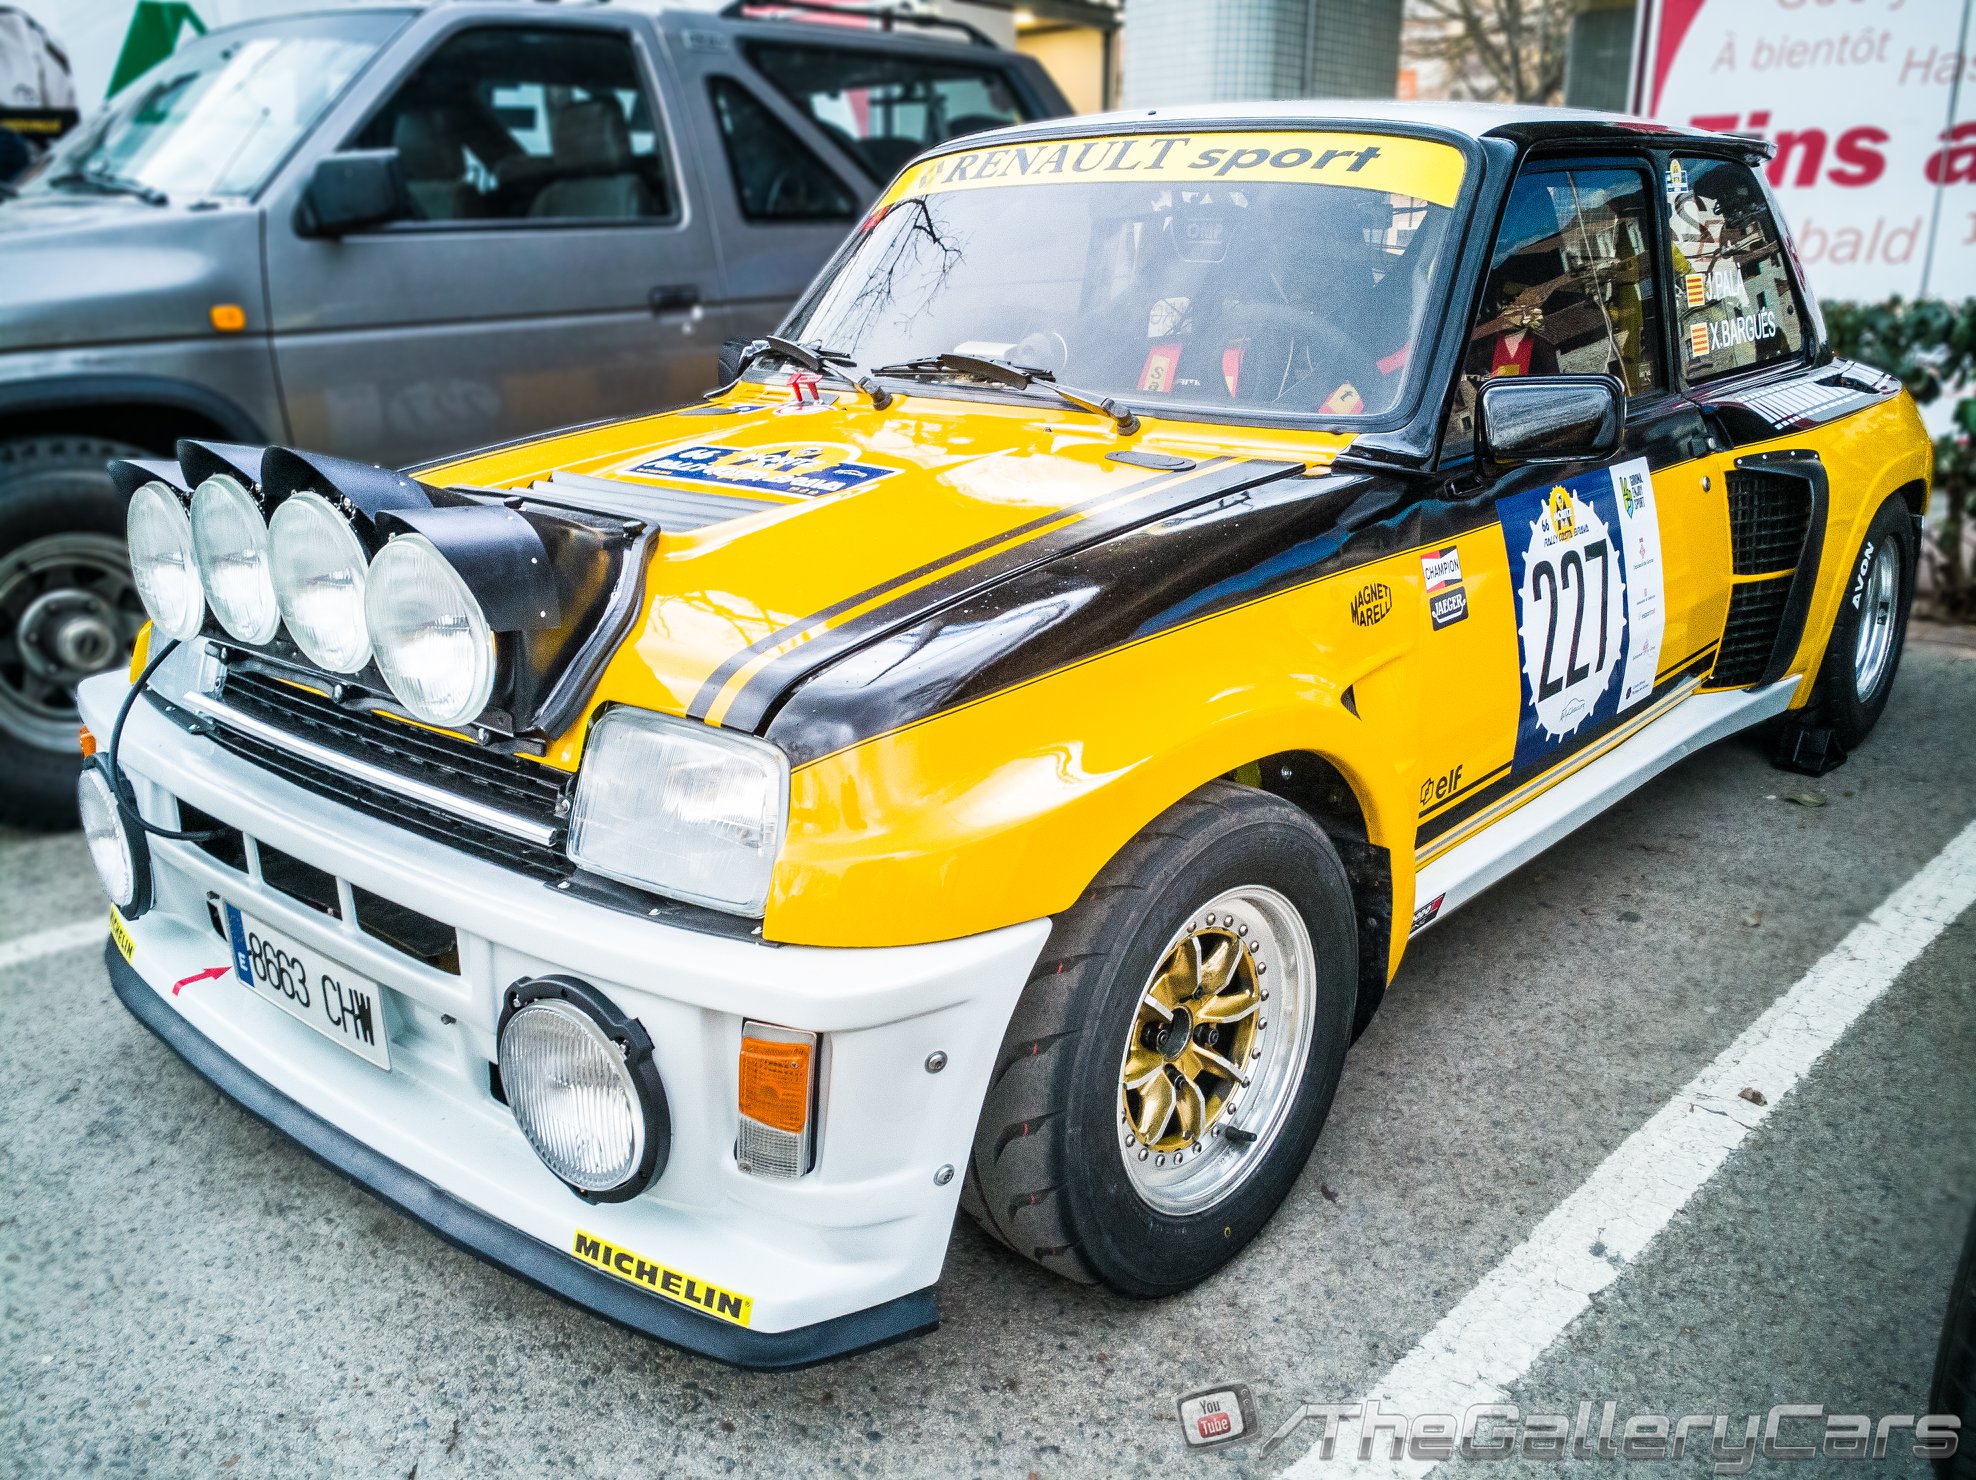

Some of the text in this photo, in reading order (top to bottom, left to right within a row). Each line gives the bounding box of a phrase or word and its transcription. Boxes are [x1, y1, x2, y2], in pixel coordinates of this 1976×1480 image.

[1751, 25, 1892, 72] bientôt
[941, 137, 1382, 183] RENAULT sport
[1690, 110, 1891, 188] ns
[1425, 559, 1459, 580] CHAMPION
[1852, 541, 1874, 610] AVON
[1432, 594, 1466, 618] JAEGER
[1532, 538, 1608, 703] 227
[1436, 764, 1463, 800] elf
[248, 932, 310, 1008] 8663
[575, 1233, 743, 1319] MICHELIN
